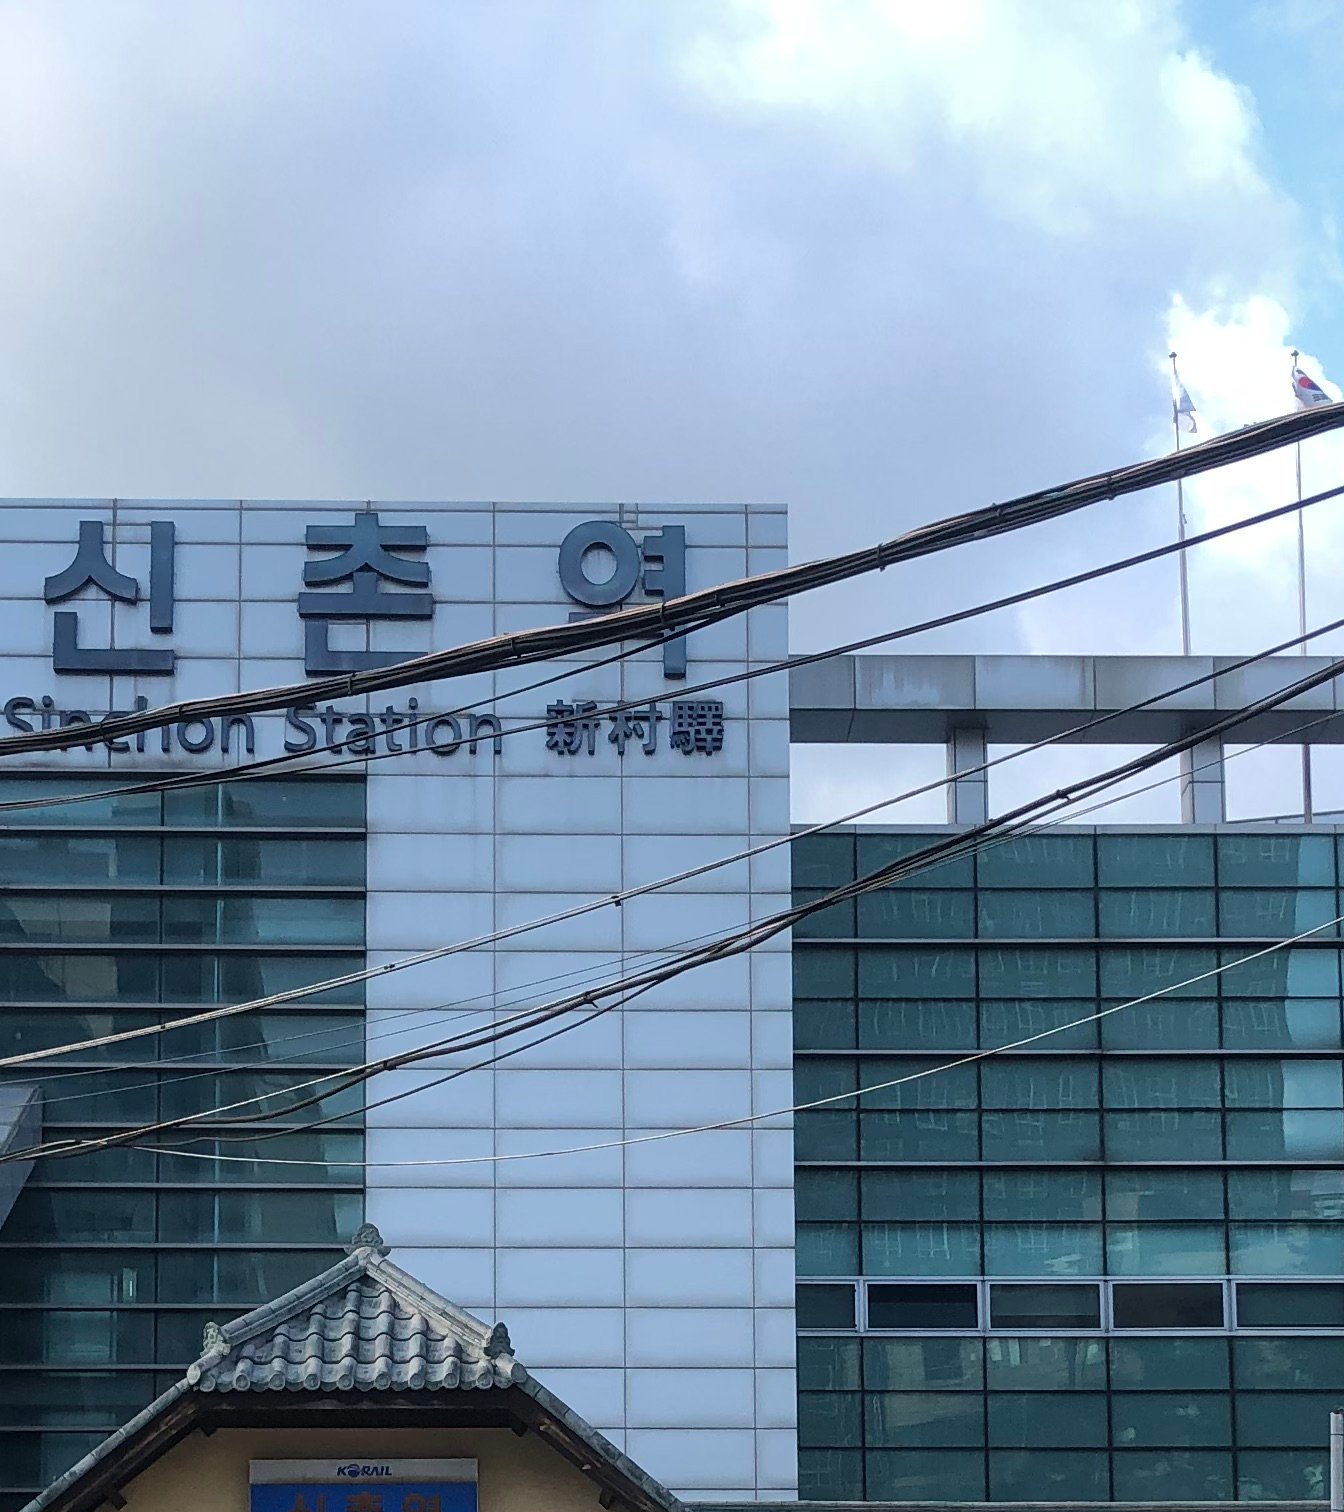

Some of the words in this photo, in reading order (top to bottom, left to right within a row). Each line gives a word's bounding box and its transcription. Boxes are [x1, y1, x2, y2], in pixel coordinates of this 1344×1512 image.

[283, 697, 504, 756] Station
[545, 699, 725, 756] 新村驛
[336, 1463, 393, 1477] KORAIL
